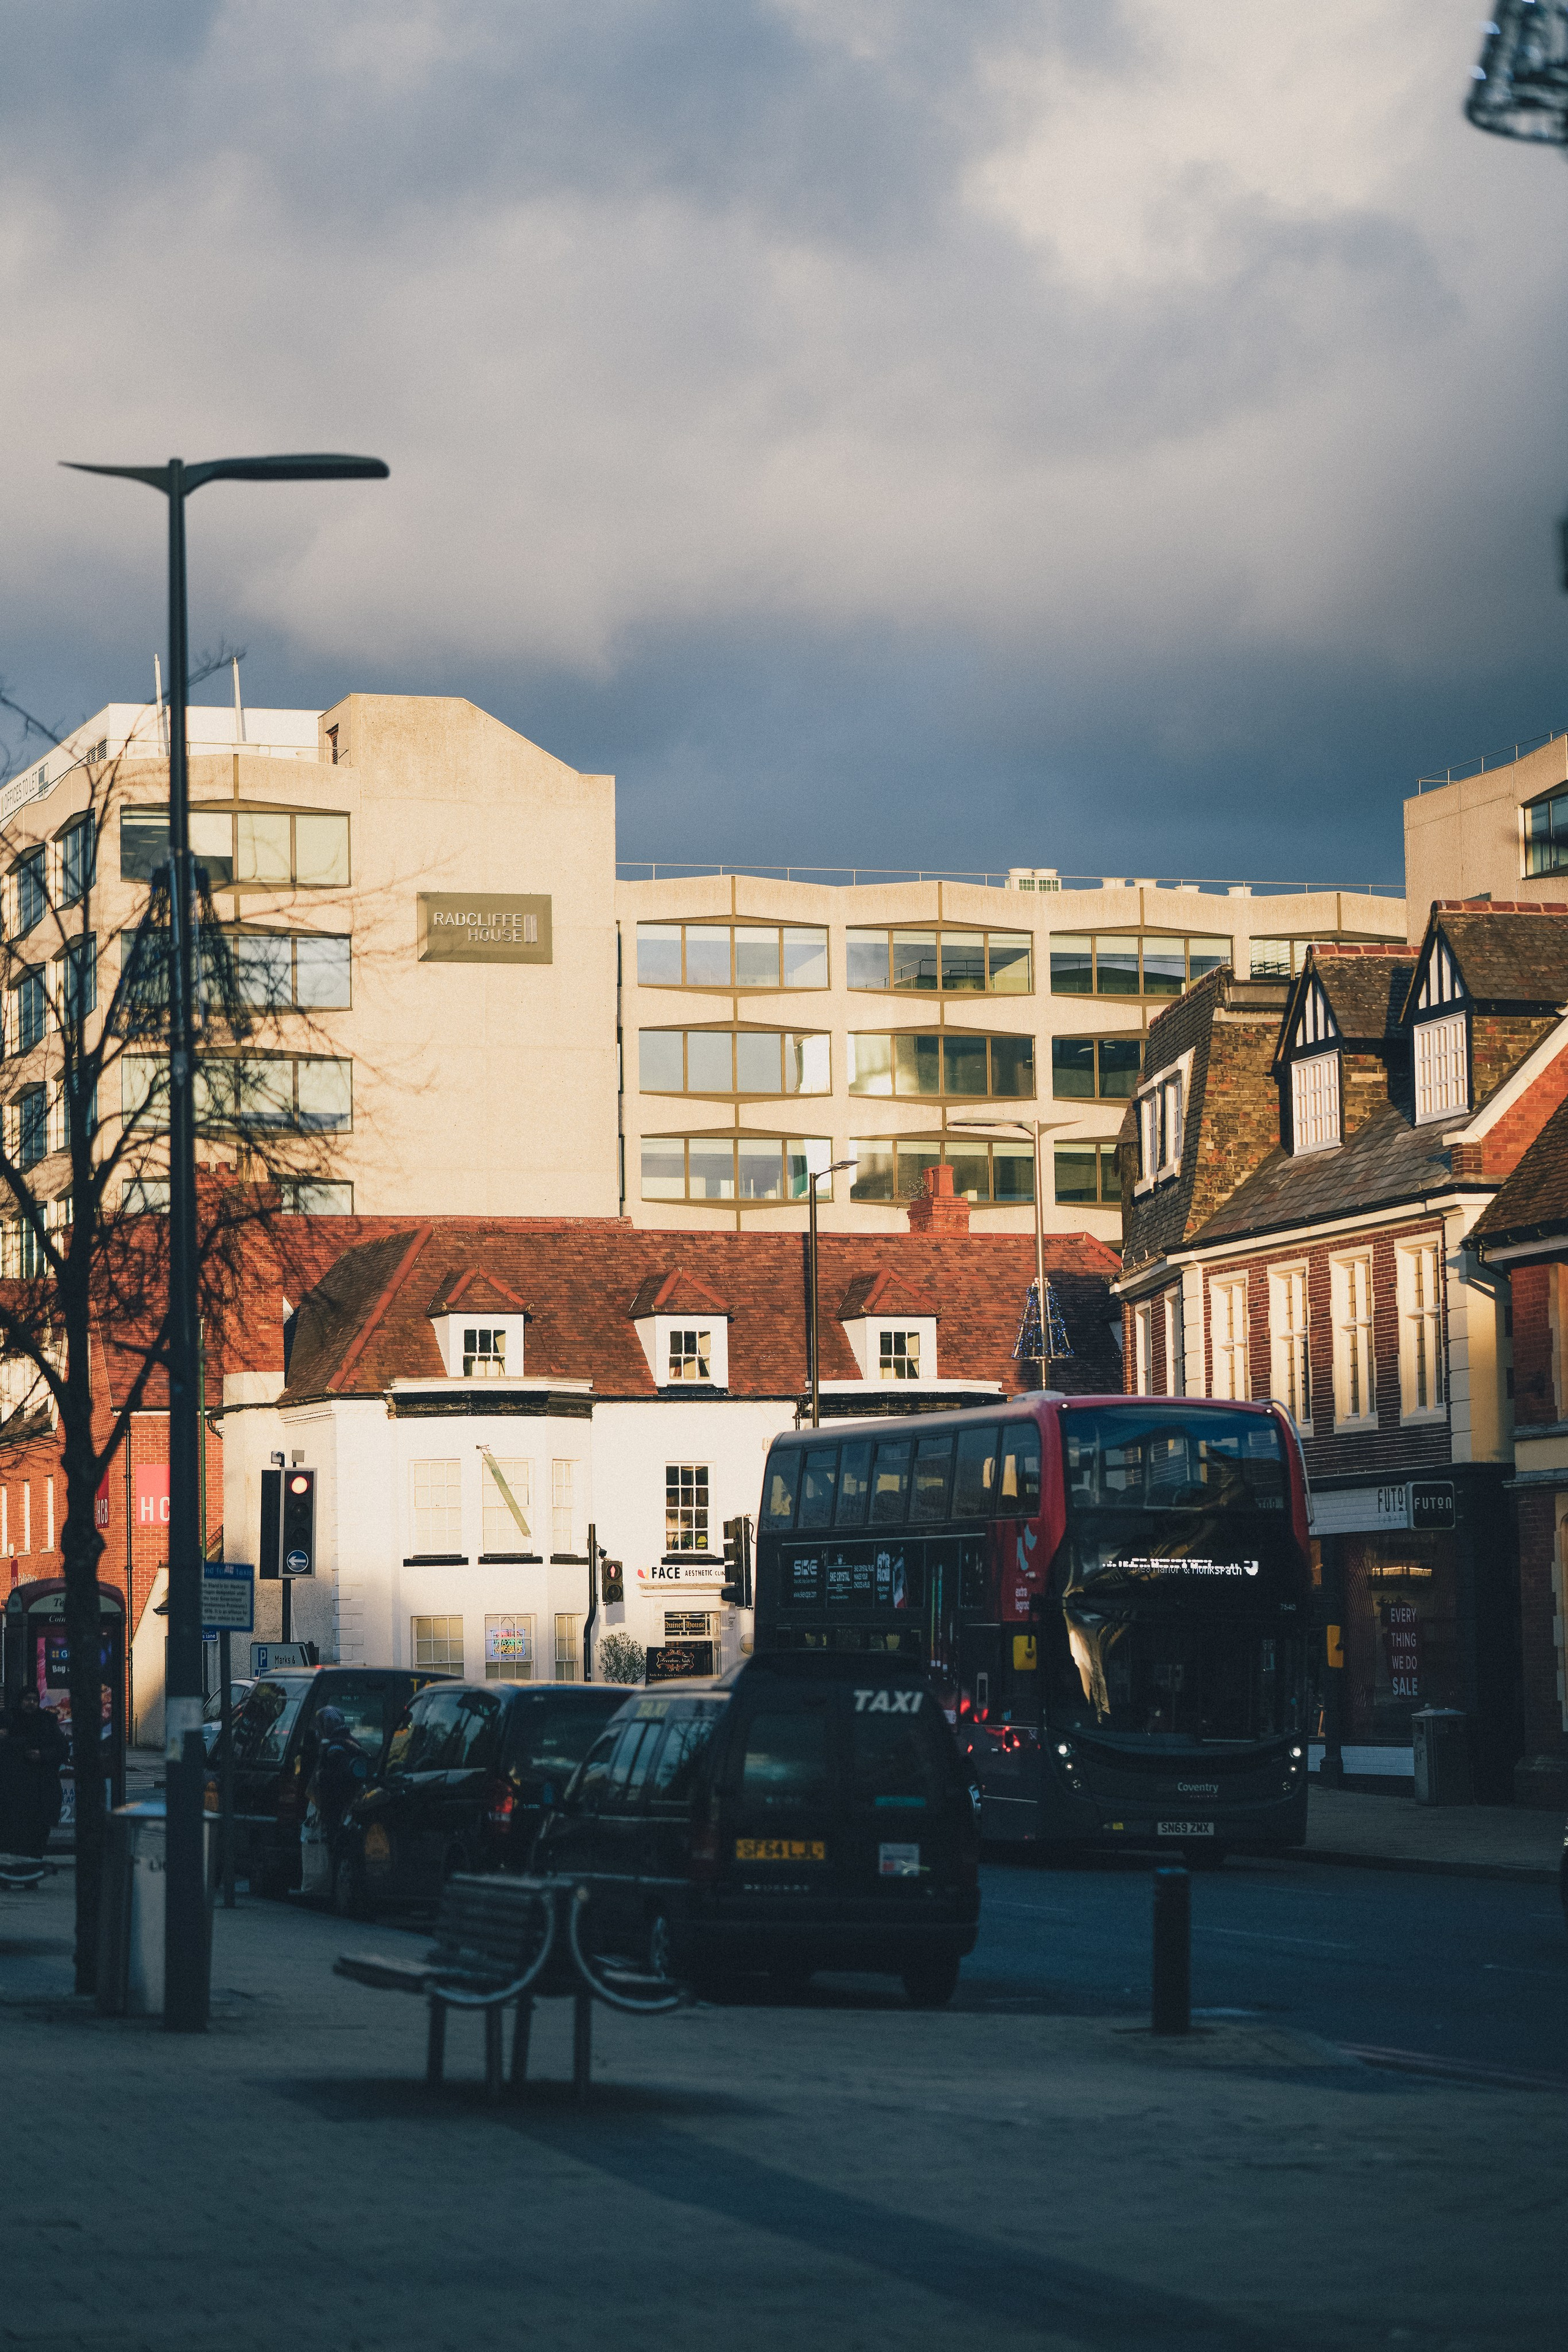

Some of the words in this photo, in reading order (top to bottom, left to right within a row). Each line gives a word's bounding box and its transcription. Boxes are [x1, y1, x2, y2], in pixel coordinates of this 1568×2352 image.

[4, 782, 22, 810] OFFICES
[23, 778, 28, 797] TO
[433, 912, 522, 927] RADCLIFFE
[467, 928, 522, 943] HOUSE
[1378, 1487, 1408, 1513] FUTO
[97, 1498, 108, 1525] HCB
[140, 1496, 170, 1522] HC
[651, 1567, 680, 1579] FACE
[793, 1559, 818, 1576] SKE
[1390, 1608, 1417, 1623] EVERY
[685, 1621, 706, 1630] House
[1391, 1632, 1417, 1648] THING
[274, 1655, 291, 1664] Marks
[292, 1655, 296, 1664] &
[1392, 1656, 1404, 1670] WE
[1406, 1656, 1417, 1670] DO
[1392, 1676, 1419, 1697] SALE
[853, 1689, 924, 1714] TAXI
[1177, 1782, 1219, 1794] Coventry
[1161, 1822, 1188, 1833] SN69
